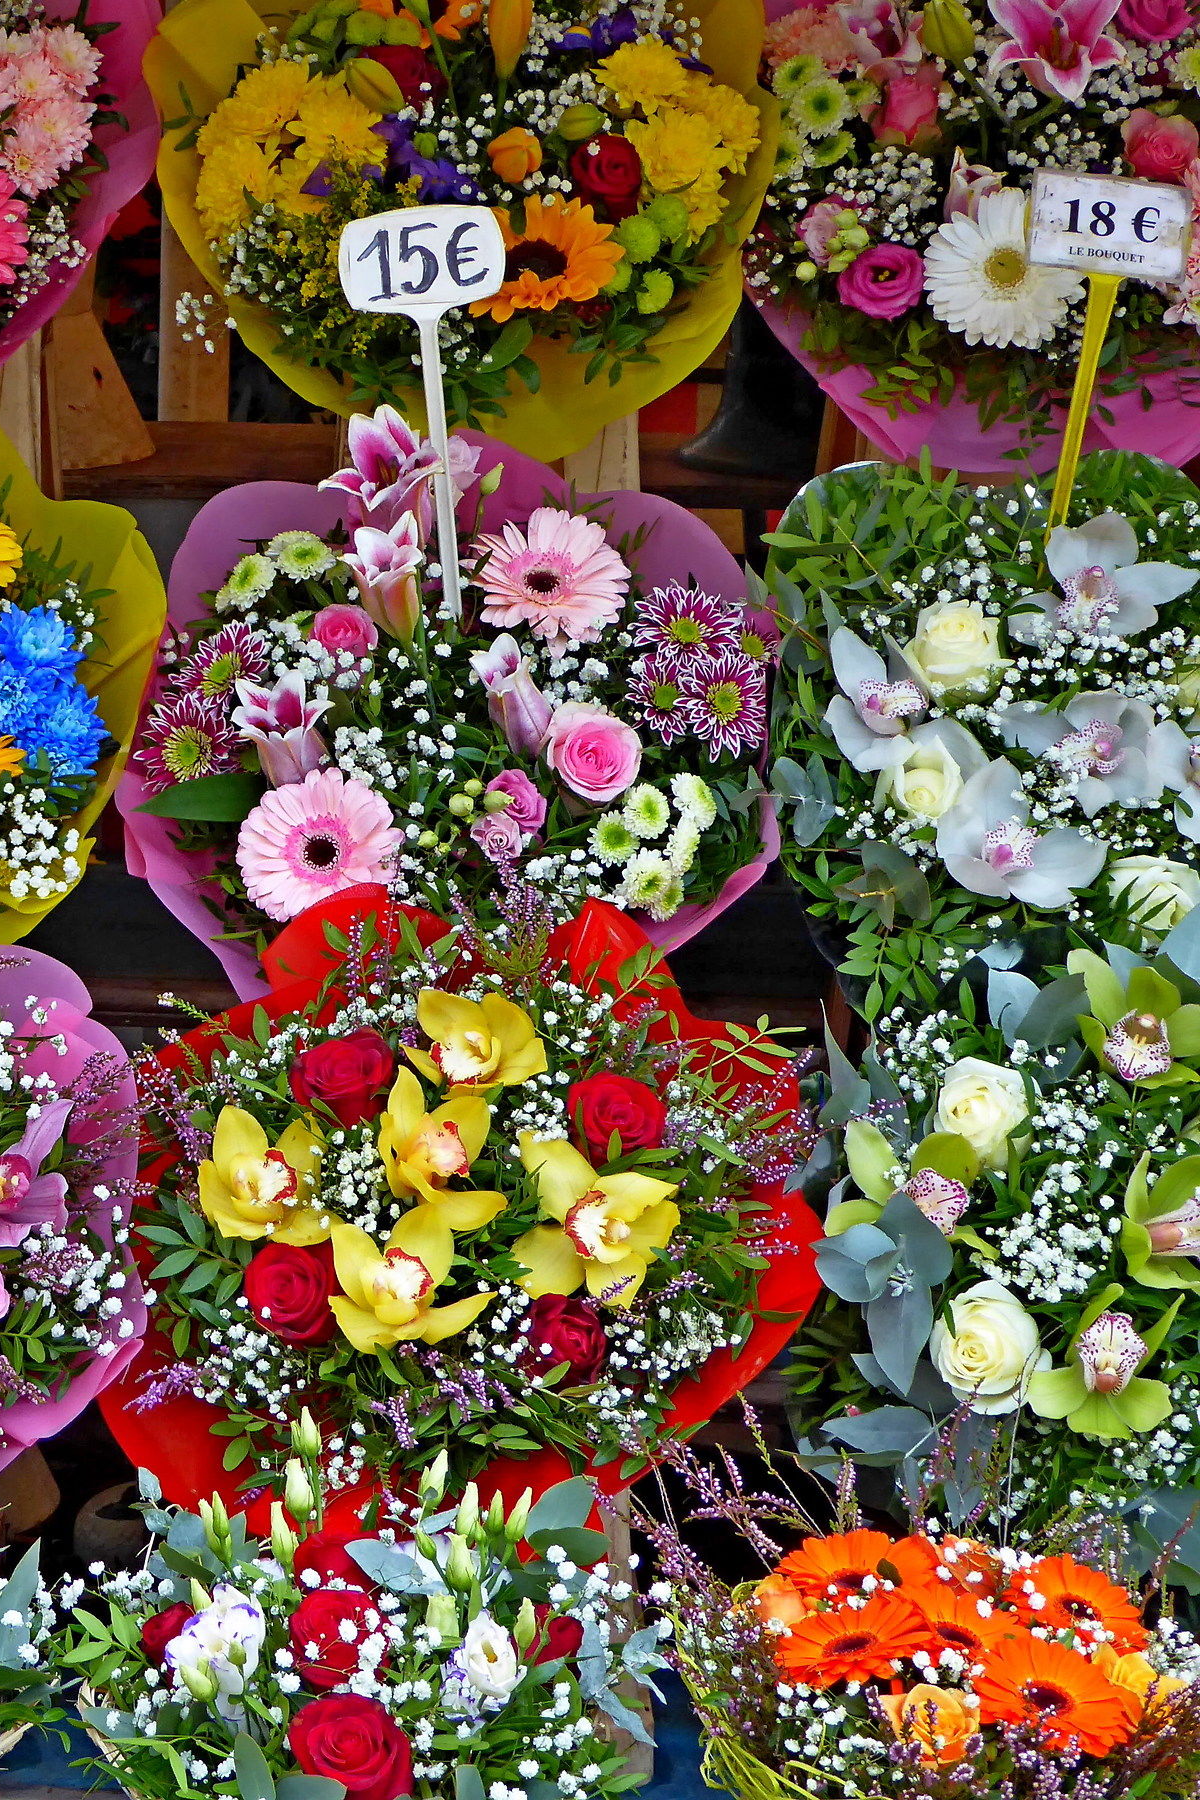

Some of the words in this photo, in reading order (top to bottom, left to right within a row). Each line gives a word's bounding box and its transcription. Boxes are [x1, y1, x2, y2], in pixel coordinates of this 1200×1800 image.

[1062, 198, 1116, 237] 18
[1131, 206, 1161, 244] €
[357, 221, 489, 302] 15€
[1069, 246, 1084, 257] LE
[1087, 248, 1146, 264] BOUQUET
